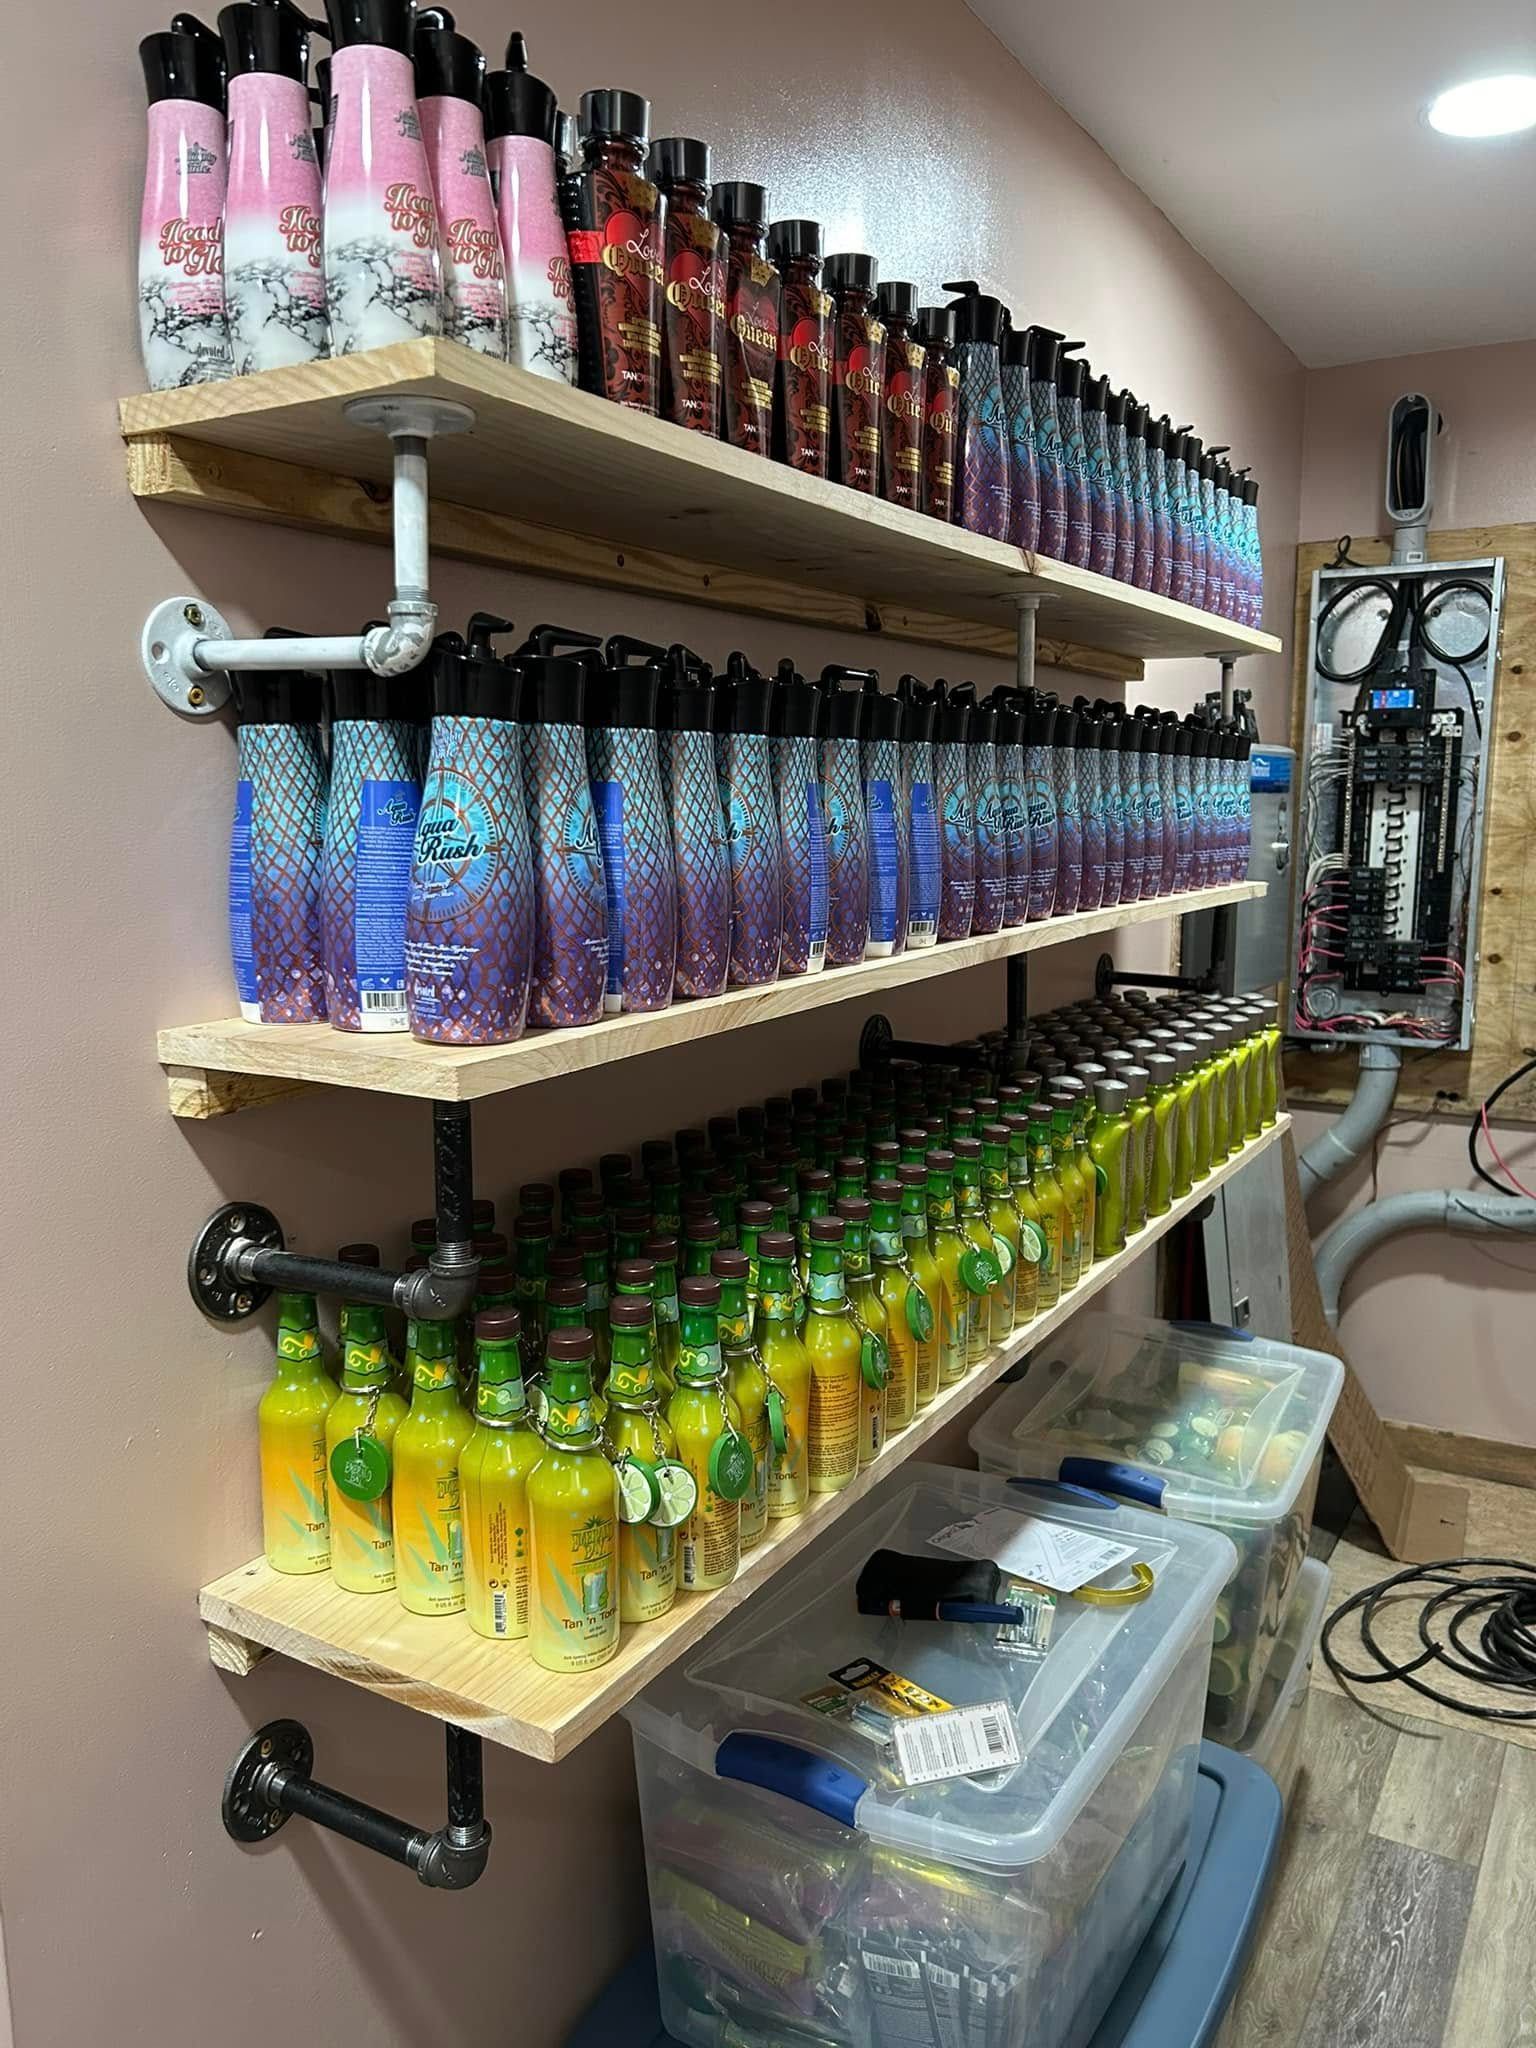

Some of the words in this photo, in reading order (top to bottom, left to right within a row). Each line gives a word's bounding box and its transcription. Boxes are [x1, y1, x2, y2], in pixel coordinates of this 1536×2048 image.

[392, 210, 414, 230] to
[288, 231, 310, 252] to
[164, 244, 185, 266] to
[453, 245, 476, 264] to
[731, 314, 777, 351] Queen
[418, 833, 484, 863] Rush
[306, 1522, 325, 1532] Tan
[372, 1540, 392, 1551] Tan
[428, 1561, 449, 1572] Tan
[452, 1561, 461, 1569] 'n
[640, 1569, 657, 1581] Tan
[562, 1618, 583, 1629] Tan
[586, 1616, 597, 1625] 'n
[600, 1606, 616, 1620] Ton
